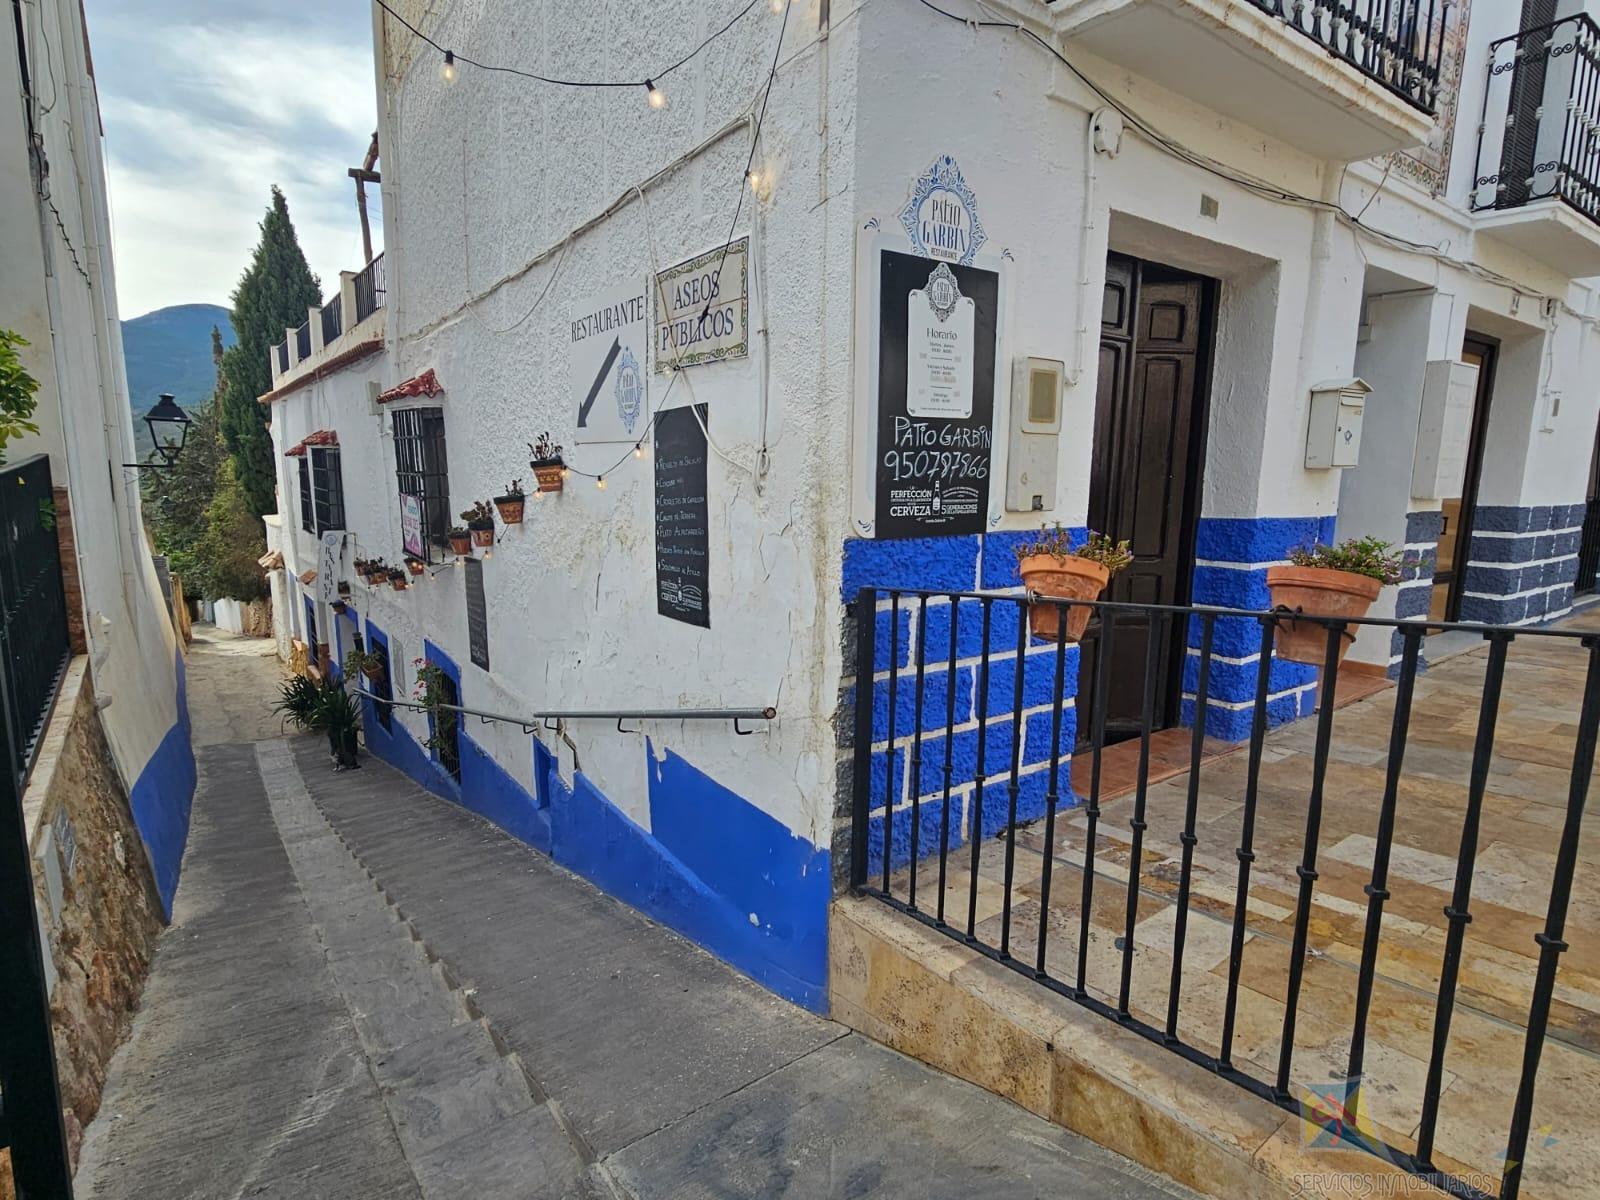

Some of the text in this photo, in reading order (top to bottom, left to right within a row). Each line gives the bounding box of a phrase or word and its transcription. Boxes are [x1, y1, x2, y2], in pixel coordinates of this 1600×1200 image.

[673, 269, 721, 311] ASEOS
[570, 295, 645, 343] RESTAURANTE
[926, 327, 958, 341] Horario
[883, 450, 988, 484] 950787866
[890, 488, 932, 498] PERFECCIÓN
[890, 506, 932, 517] CERVEZA
